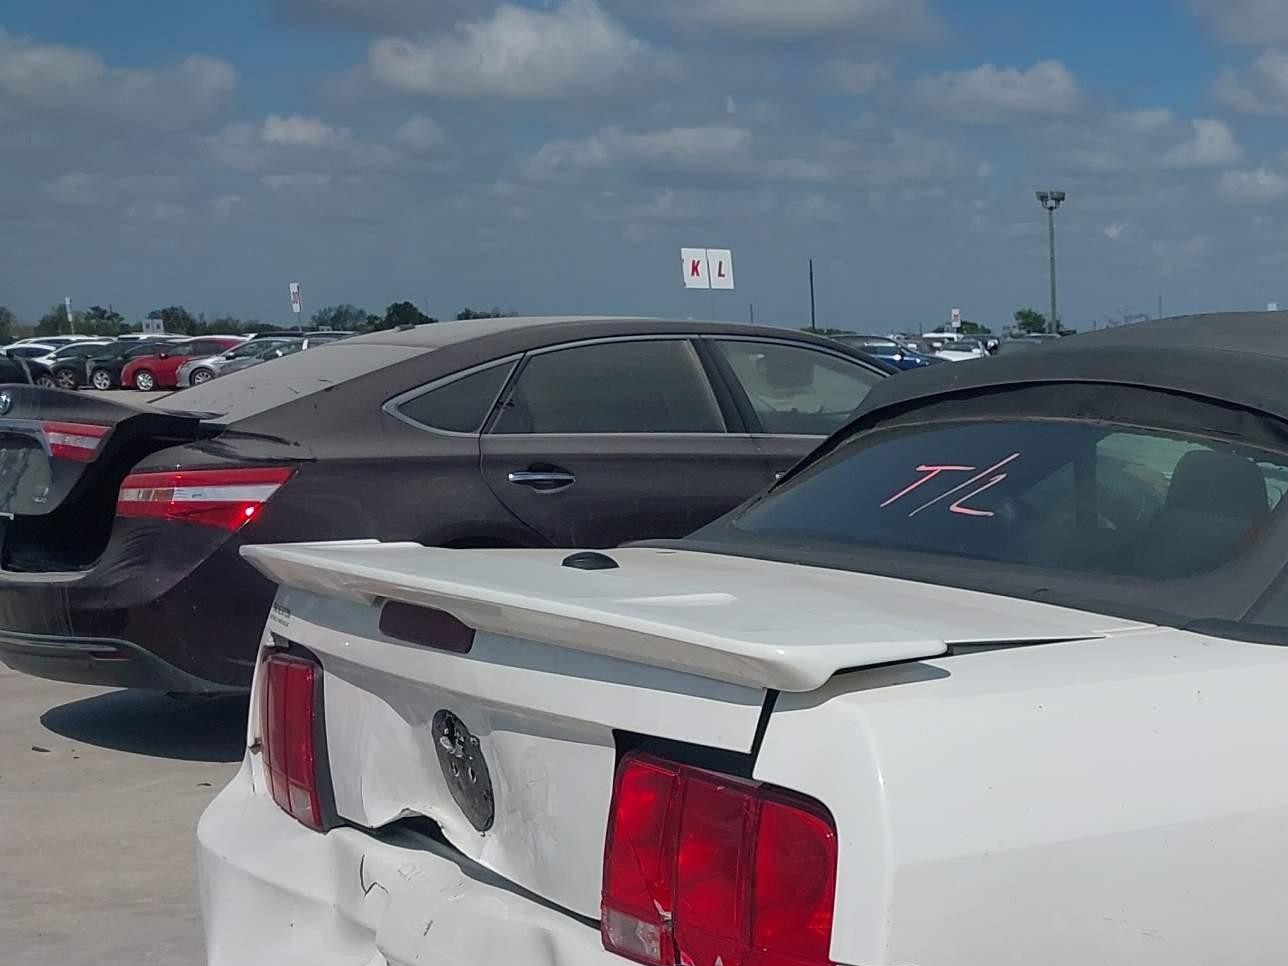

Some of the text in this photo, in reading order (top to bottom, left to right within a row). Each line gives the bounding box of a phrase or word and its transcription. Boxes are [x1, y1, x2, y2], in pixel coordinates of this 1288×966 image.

[691, 259, 726, 278] K L
[879, 452, 1021, 518] T/L
